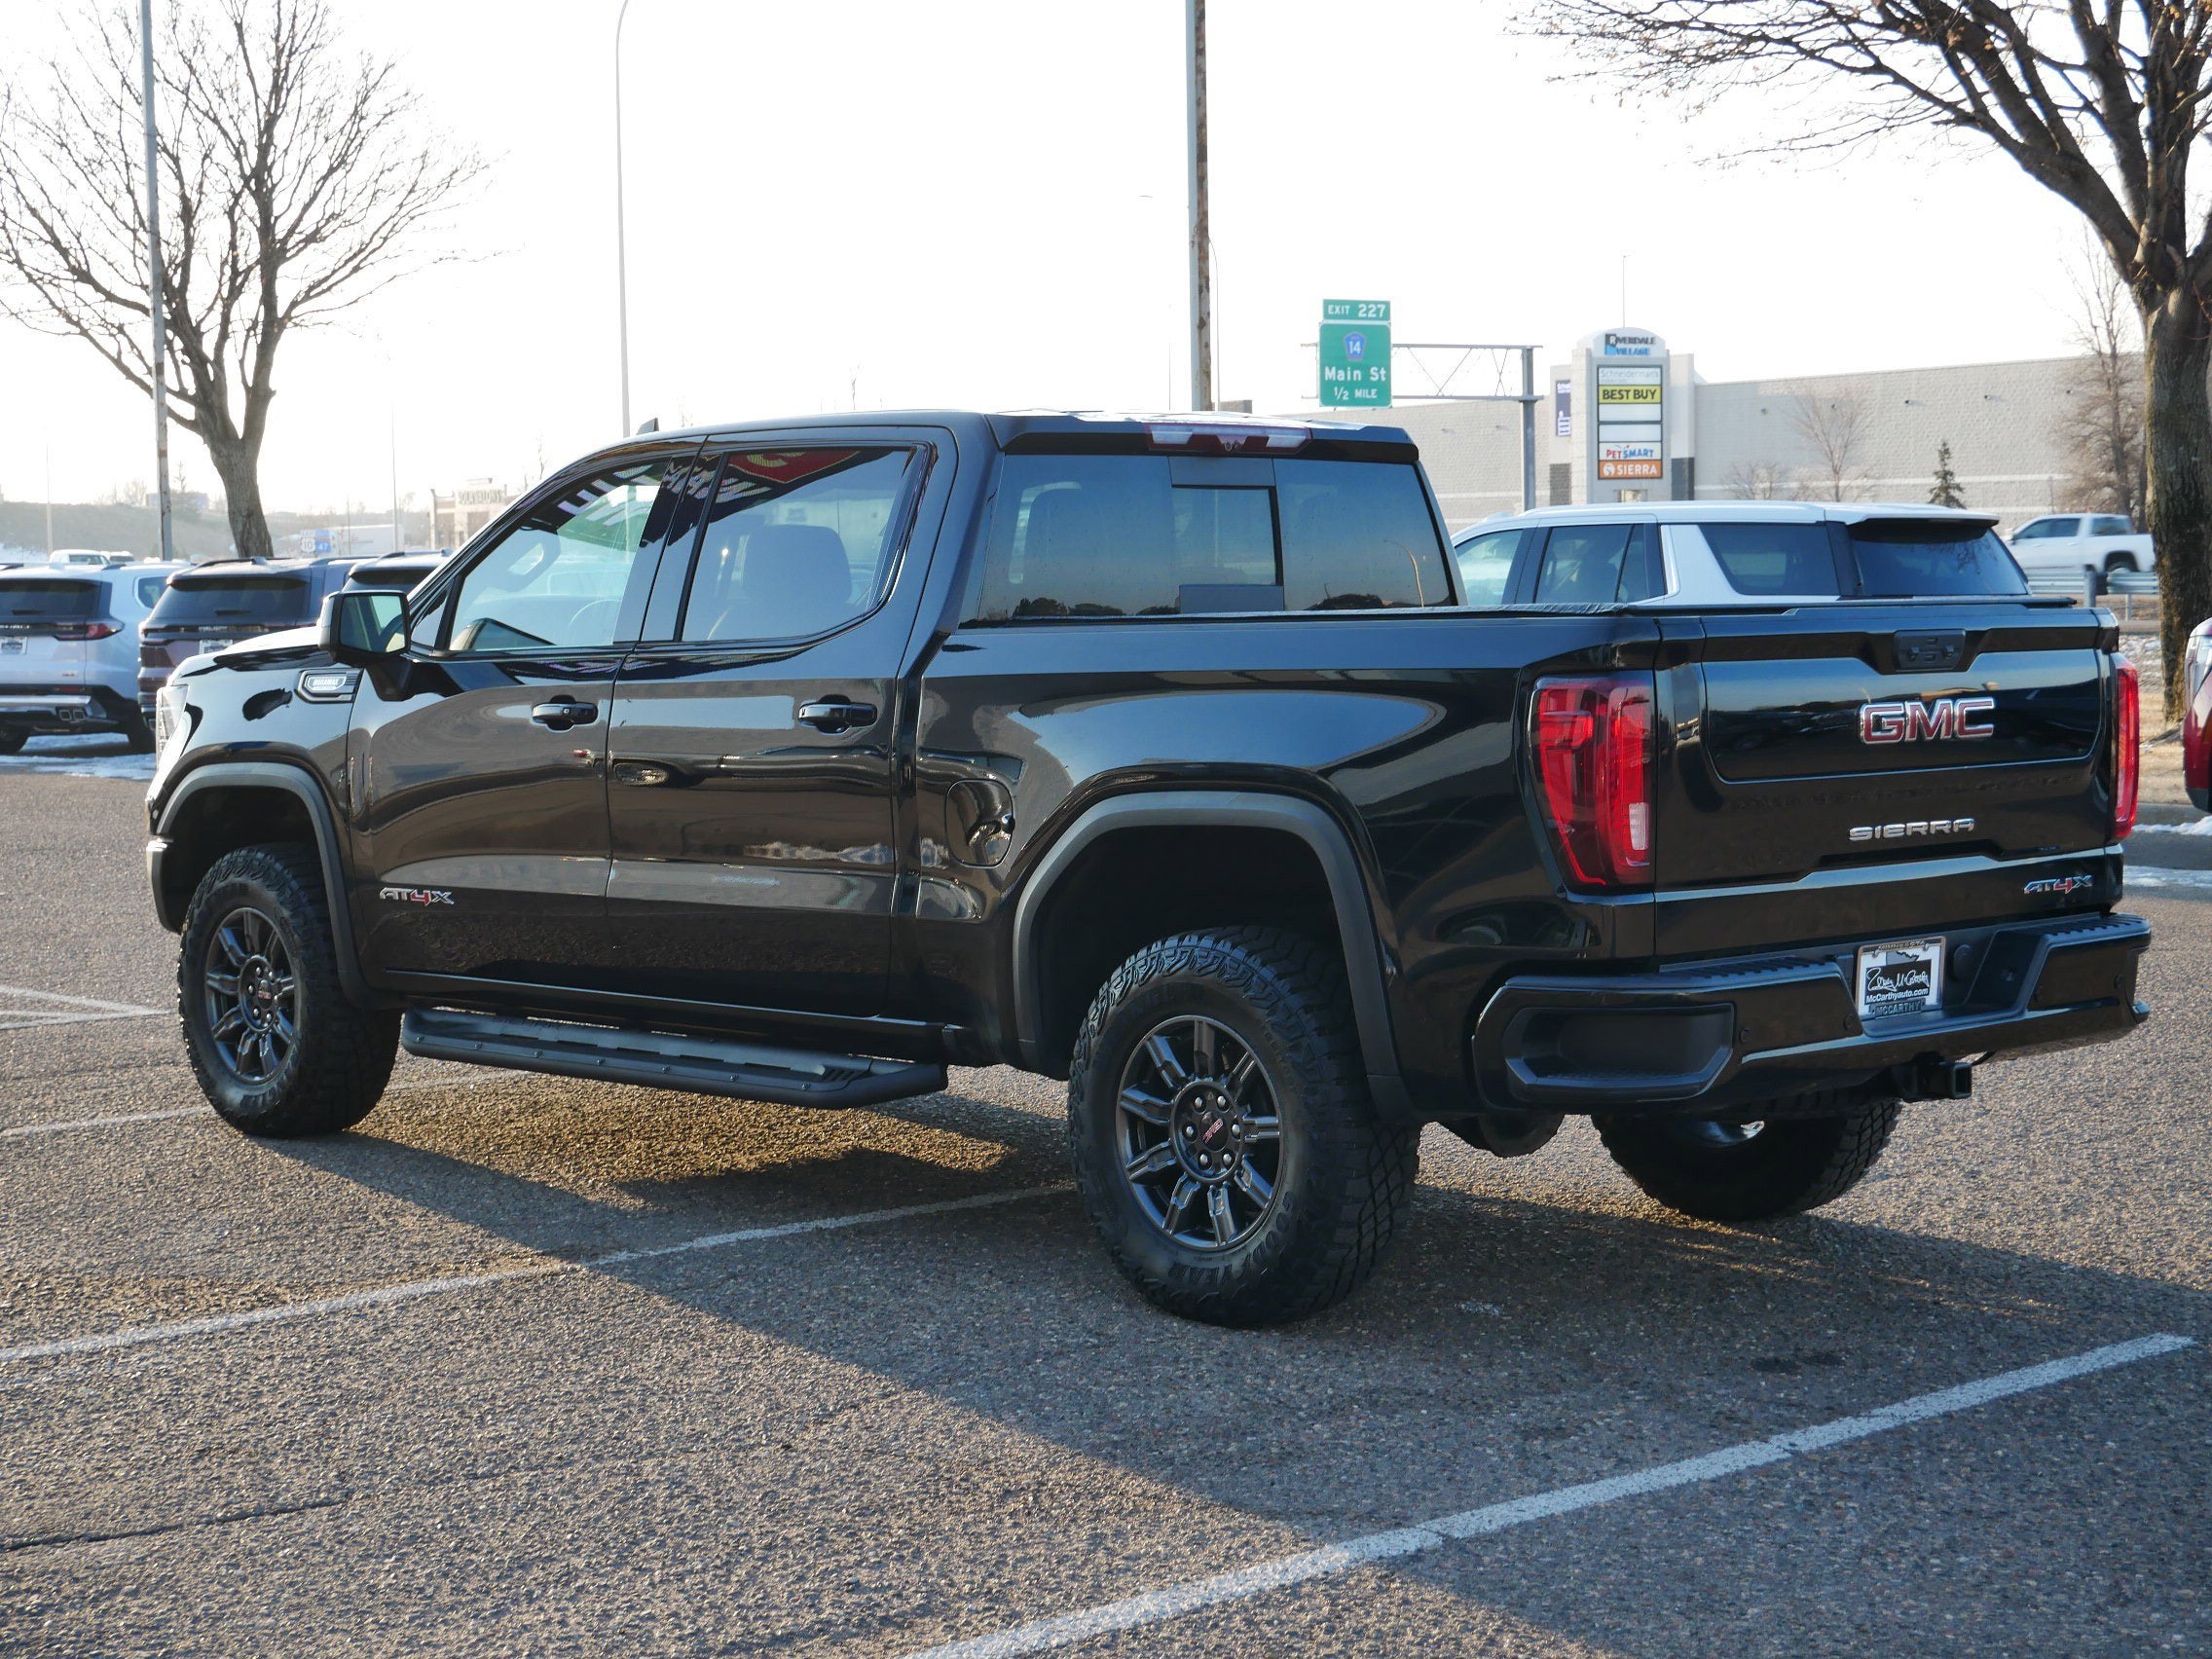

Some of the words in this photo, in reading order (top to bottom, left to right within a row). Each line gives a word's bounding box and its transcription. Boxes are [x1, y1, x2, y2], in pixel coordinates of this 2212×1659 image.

[1327, 304, 1350, 315] EXIT
[1357, 303, 1386, 317] 227
[1348, 341, 1361, 354] 14
[1609, 335, 1656, 347] RIVERDALE
[1616, 347, 1650, 355] VILLAGE
[1324, 366, 1362, 382] Main
[1370, 366, 1386, 382] St
[1354, 388, 1379, 399] MILE
[1603, 388, 1632, 400] BEST
[1633, 388, 1657, 400] BUY
[1616, 464, 1658, 475] SIERRA
[303, 540, 313, 550] 10
[1860, 696, 1995, 745] GMC
[1849, 818, 1975, 842] SIERRA
[2023, 874, 2092, 895] AT4X
[379, 886, 455, 907] AT4X
[1865, 987, 1929, 1004] McCarthyauto.com
[1875, 999, 1922, 1015] MCCARTHY
